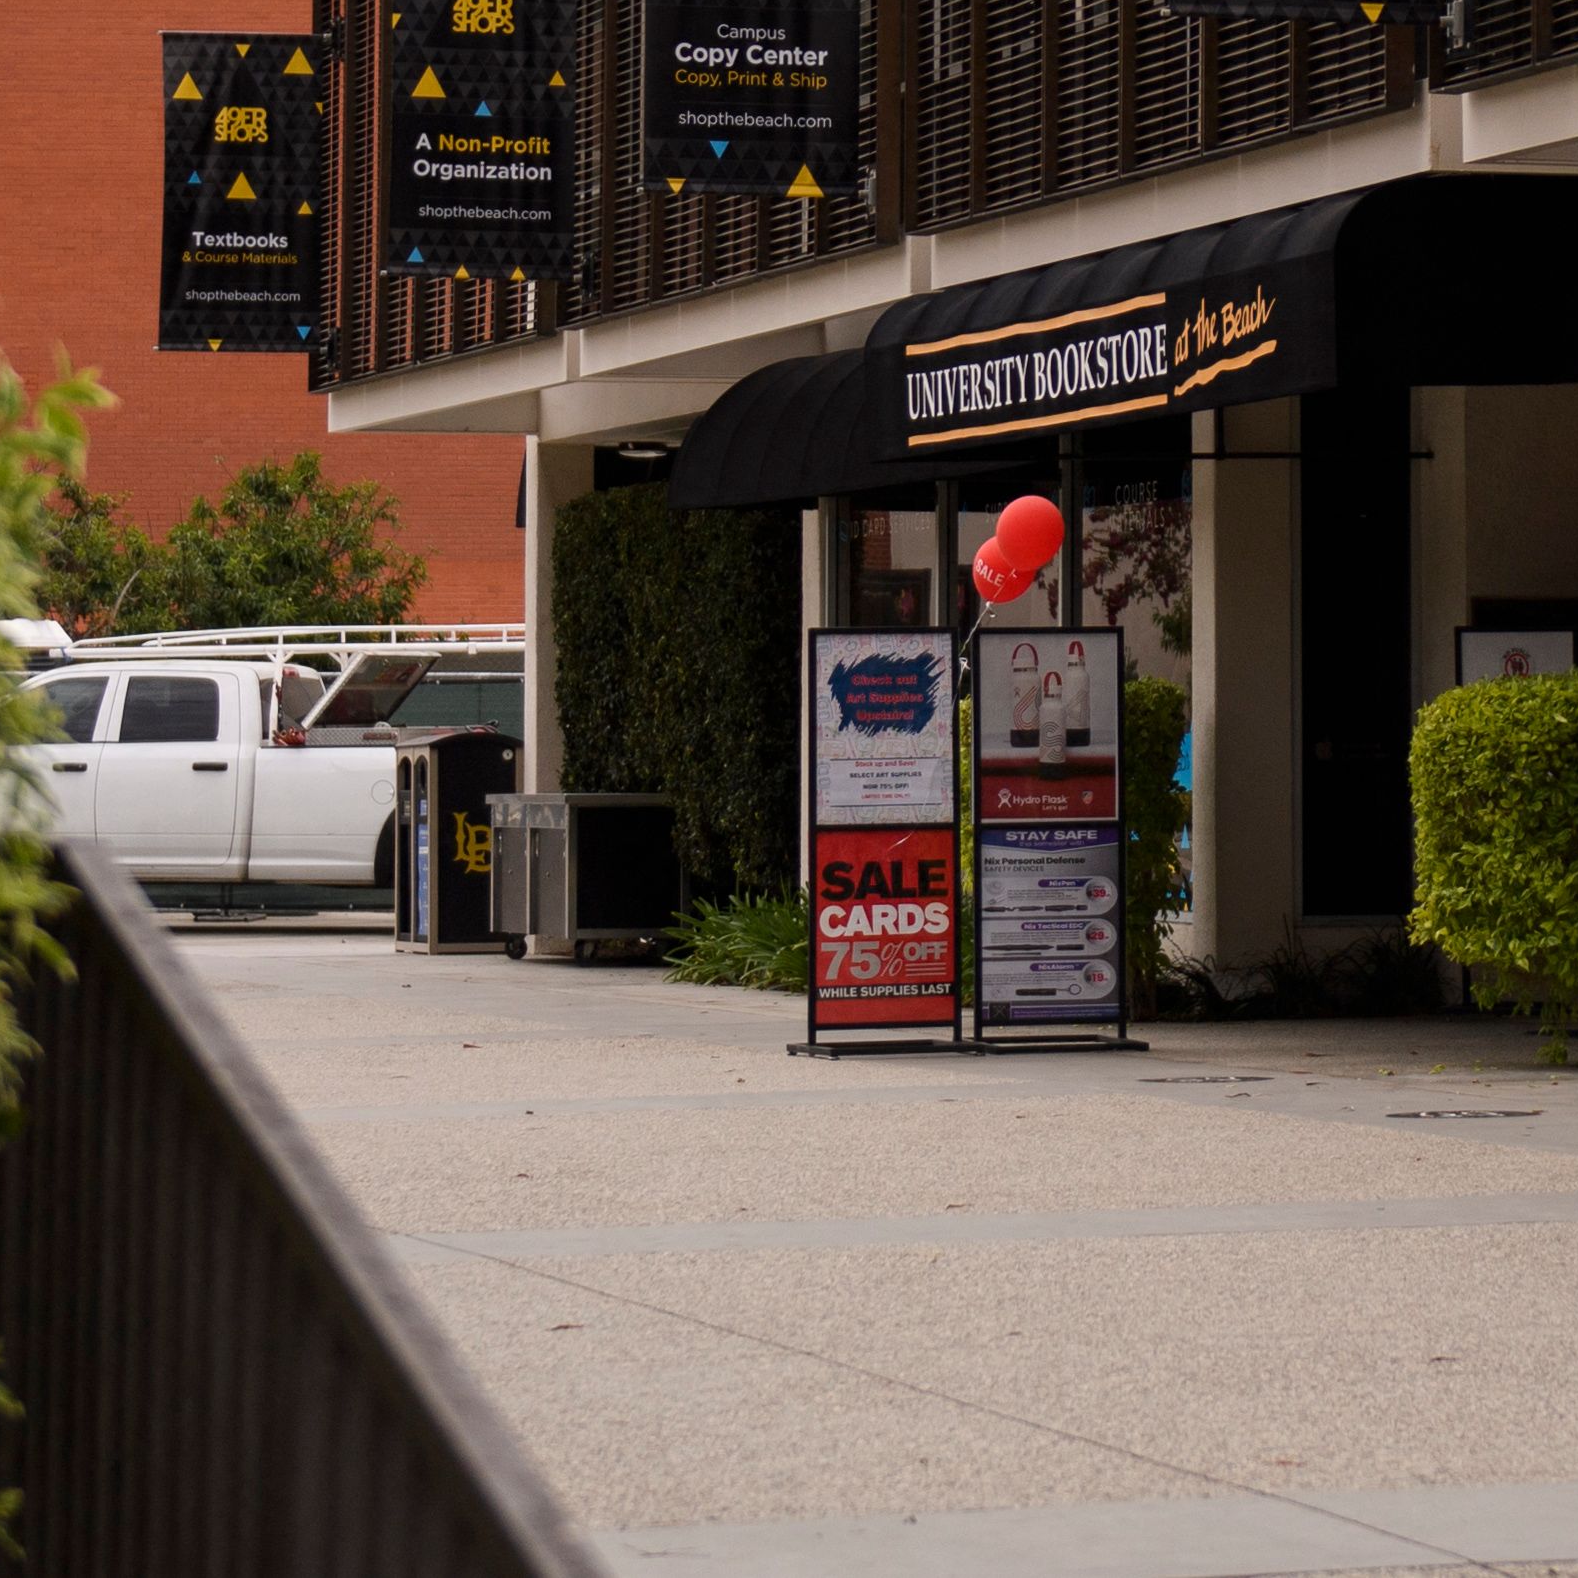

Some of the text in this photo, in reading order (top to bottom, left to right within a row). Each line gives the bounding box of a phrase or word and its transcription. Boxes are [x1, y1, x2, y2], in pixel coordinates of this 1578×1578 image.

[452, 10, 515, 35] SHOPS
[717, 23, 786, 42] Campus
[675, 42, 828, 68] Copy Center
[675, 69, 827, 91] Copy, Print & Ship
[214, 106, 267, 131] 49ER
[678, 110, 832, 130] shopthebeach.com
[214, 122, 268, 143] SHOPS
[415, 133, 551, 155] A Non-Profit
[413, 159, 553, 184] Organization
[418, 205, 552, 222] shopthebeach.com
[192, 231, 289, 249] Textbooks
[182, 251, 298, 265] & Course Materials
[185, 288, 301, 304] shopthebeach.com
[907, 285, 1276, 420] UNIVERSITY BOOKSTORE at the Beach
[1115, 481, 1158, 506] COURSE
[975, 558, 1005, 587] SALE
[1012, 794, 1068, 805] Hydro Flask
[1006, 830, 1098, 841] STAY SAFE
[984, 856, 1085, 865] Nix Personal Defense
[821, 860, 948, 900] SALE
[820, 903, 949, 937] CARDS
[821, 941, 948, 980] 75% OFF
[819, 983, 951, 999] WHILE SUPPLIES LAST
